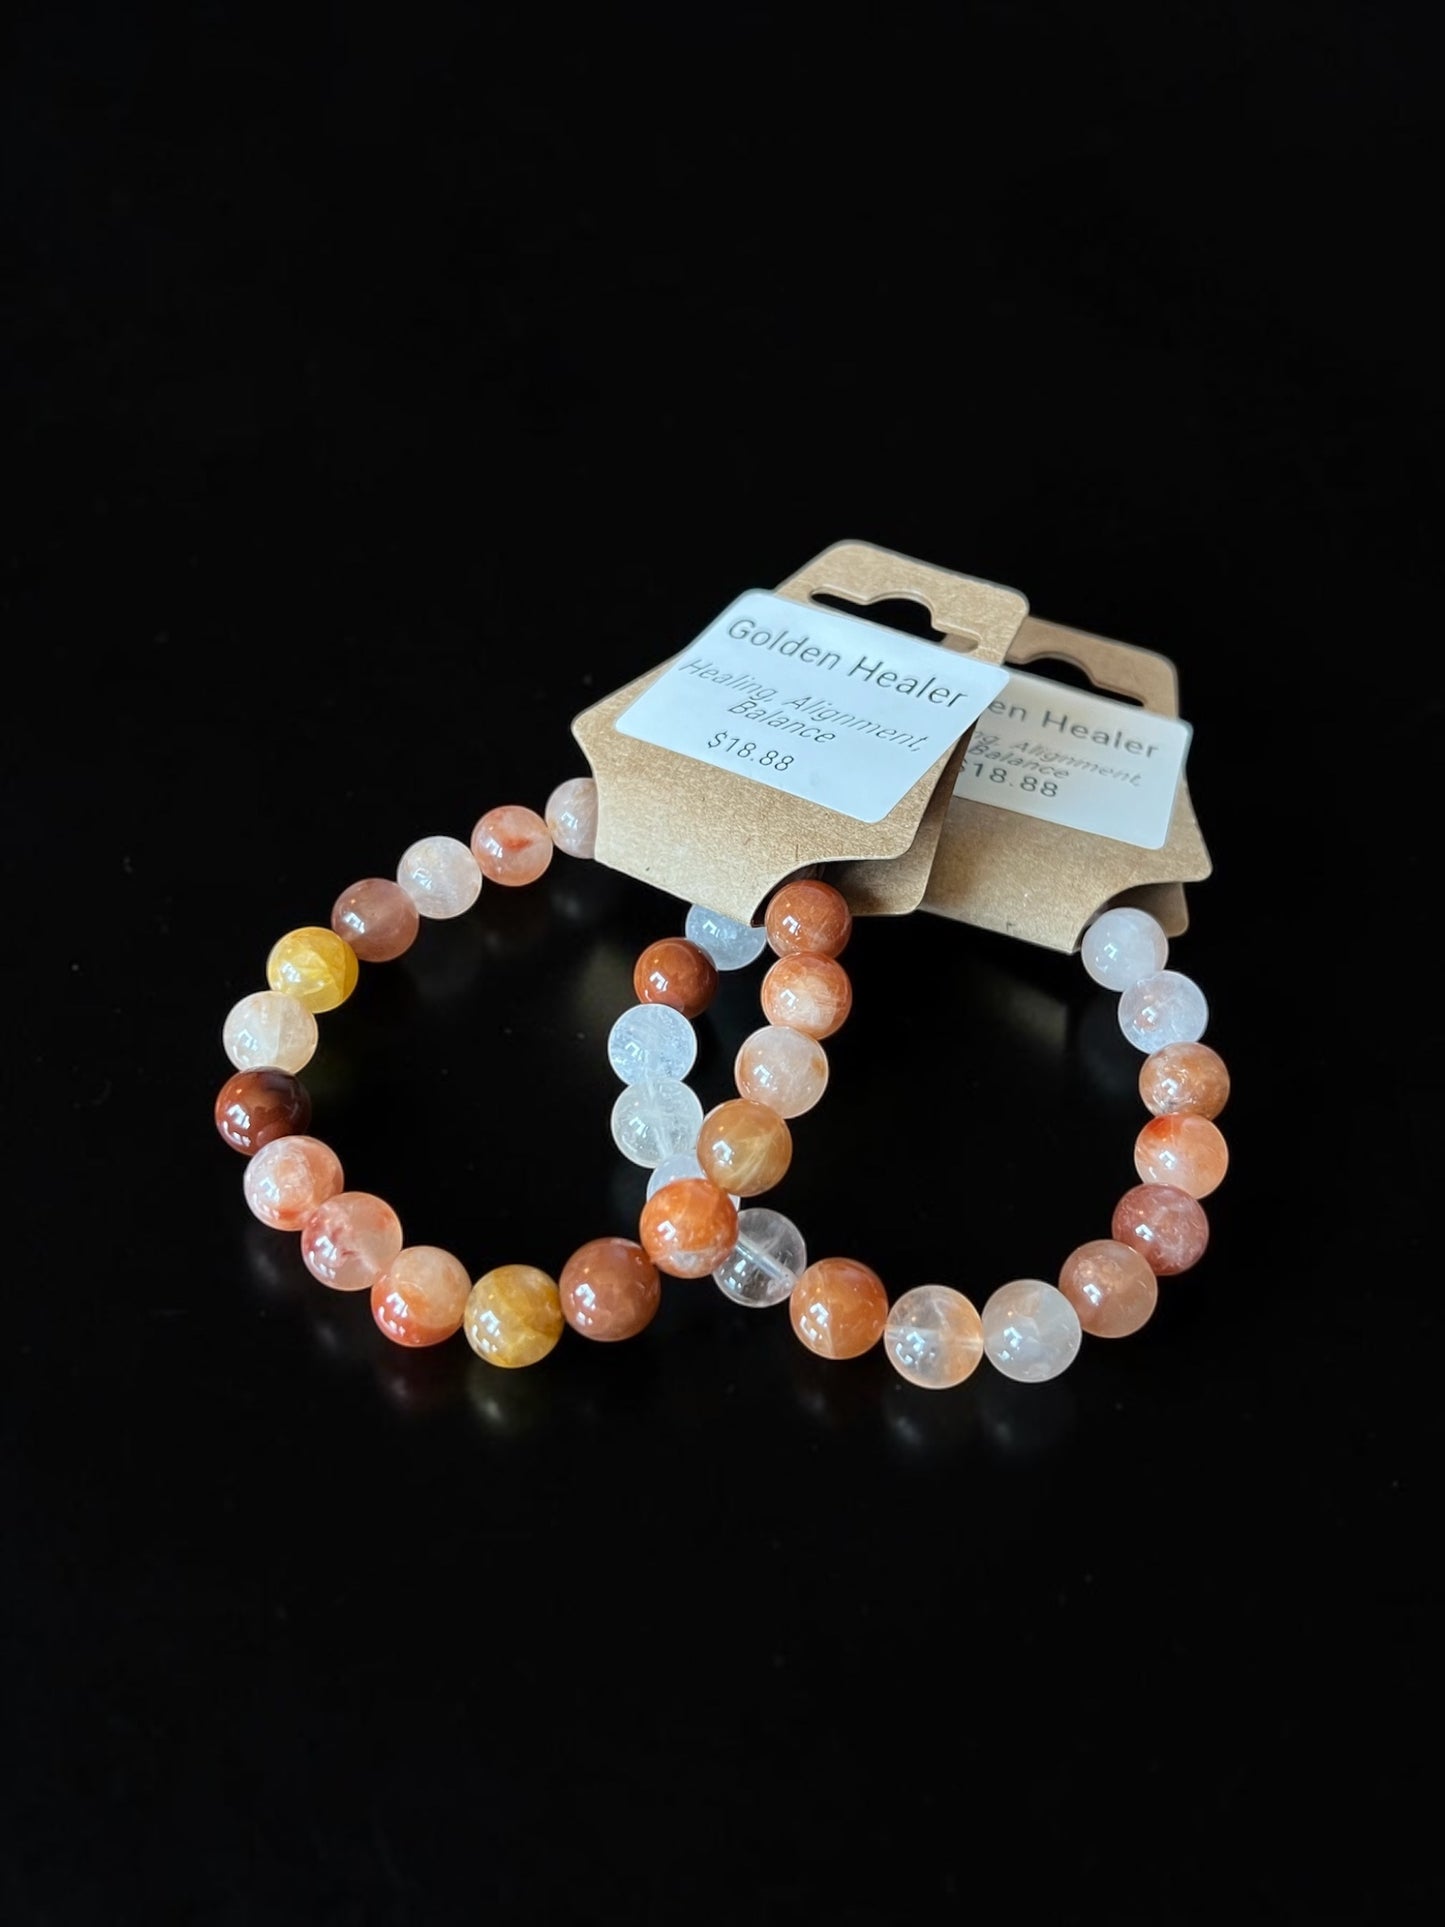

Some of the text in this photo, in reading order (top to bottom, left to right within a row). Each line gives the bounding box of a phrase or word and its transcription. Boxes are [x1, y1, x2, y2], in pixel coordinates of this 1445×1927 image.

[727, 618, 969, 708] Golden Healer
[678, 659, 930, 752] Healing, Alignment,
[728, 699, 836, 744] Balance
[707, 730, 795, 772] $18.88
[1042, 710, 1159, 758] Healer
[968, 744, 1070, 779] Balance
